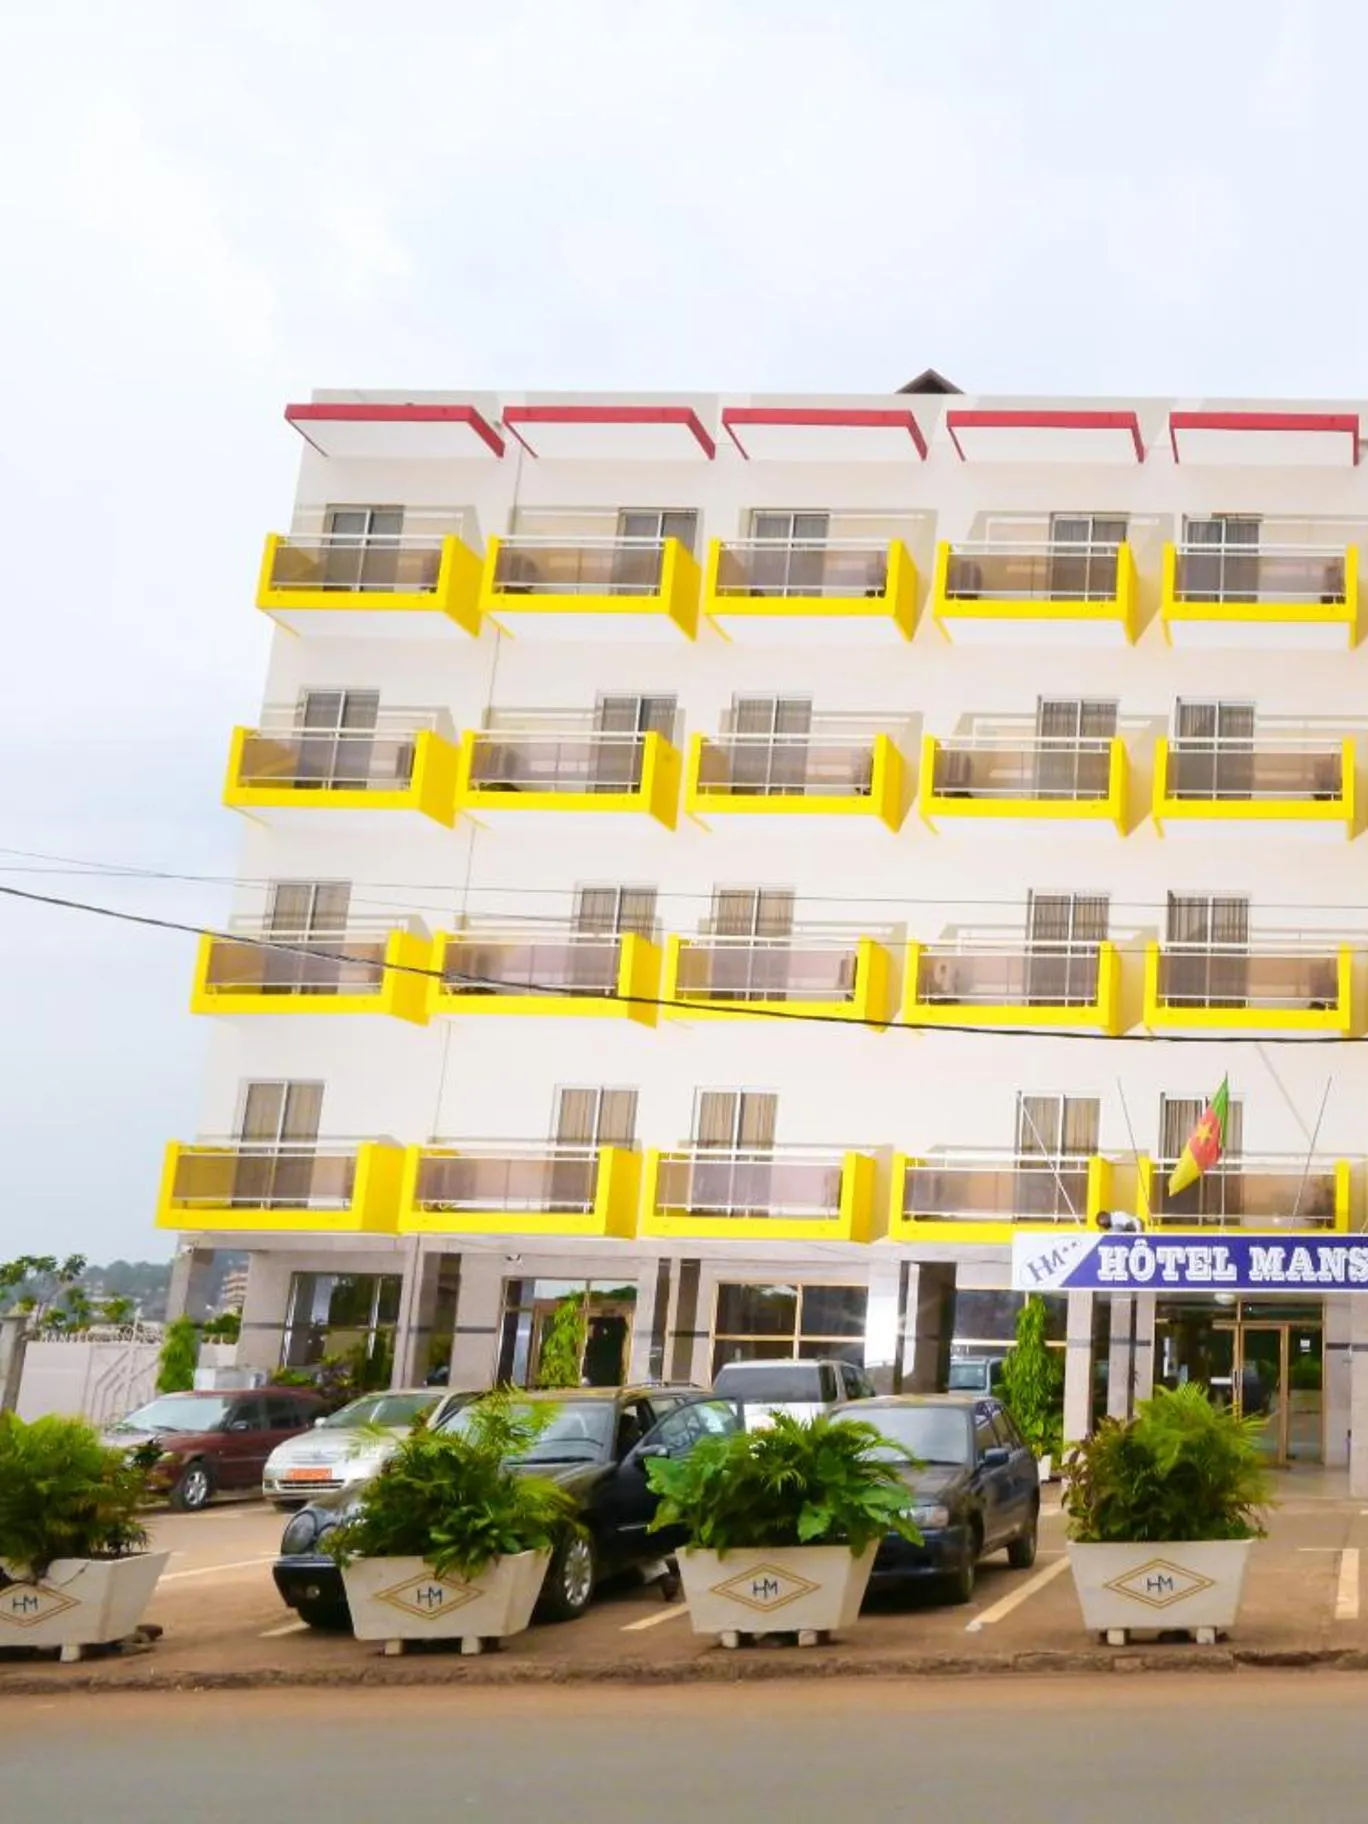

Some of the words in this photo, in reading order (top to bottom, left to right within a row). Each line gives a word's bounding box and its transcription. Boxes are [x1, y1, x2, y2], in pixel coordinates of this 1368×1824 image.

[1097, 1239, 1237, 1282] HÔTEL
[753, 1578, 778, 1598] HM
[1147, 1574, 1173, 1593] HM
[12, 1594, 38, 1613] HM
[417, 1586, 443, 1608] HM
